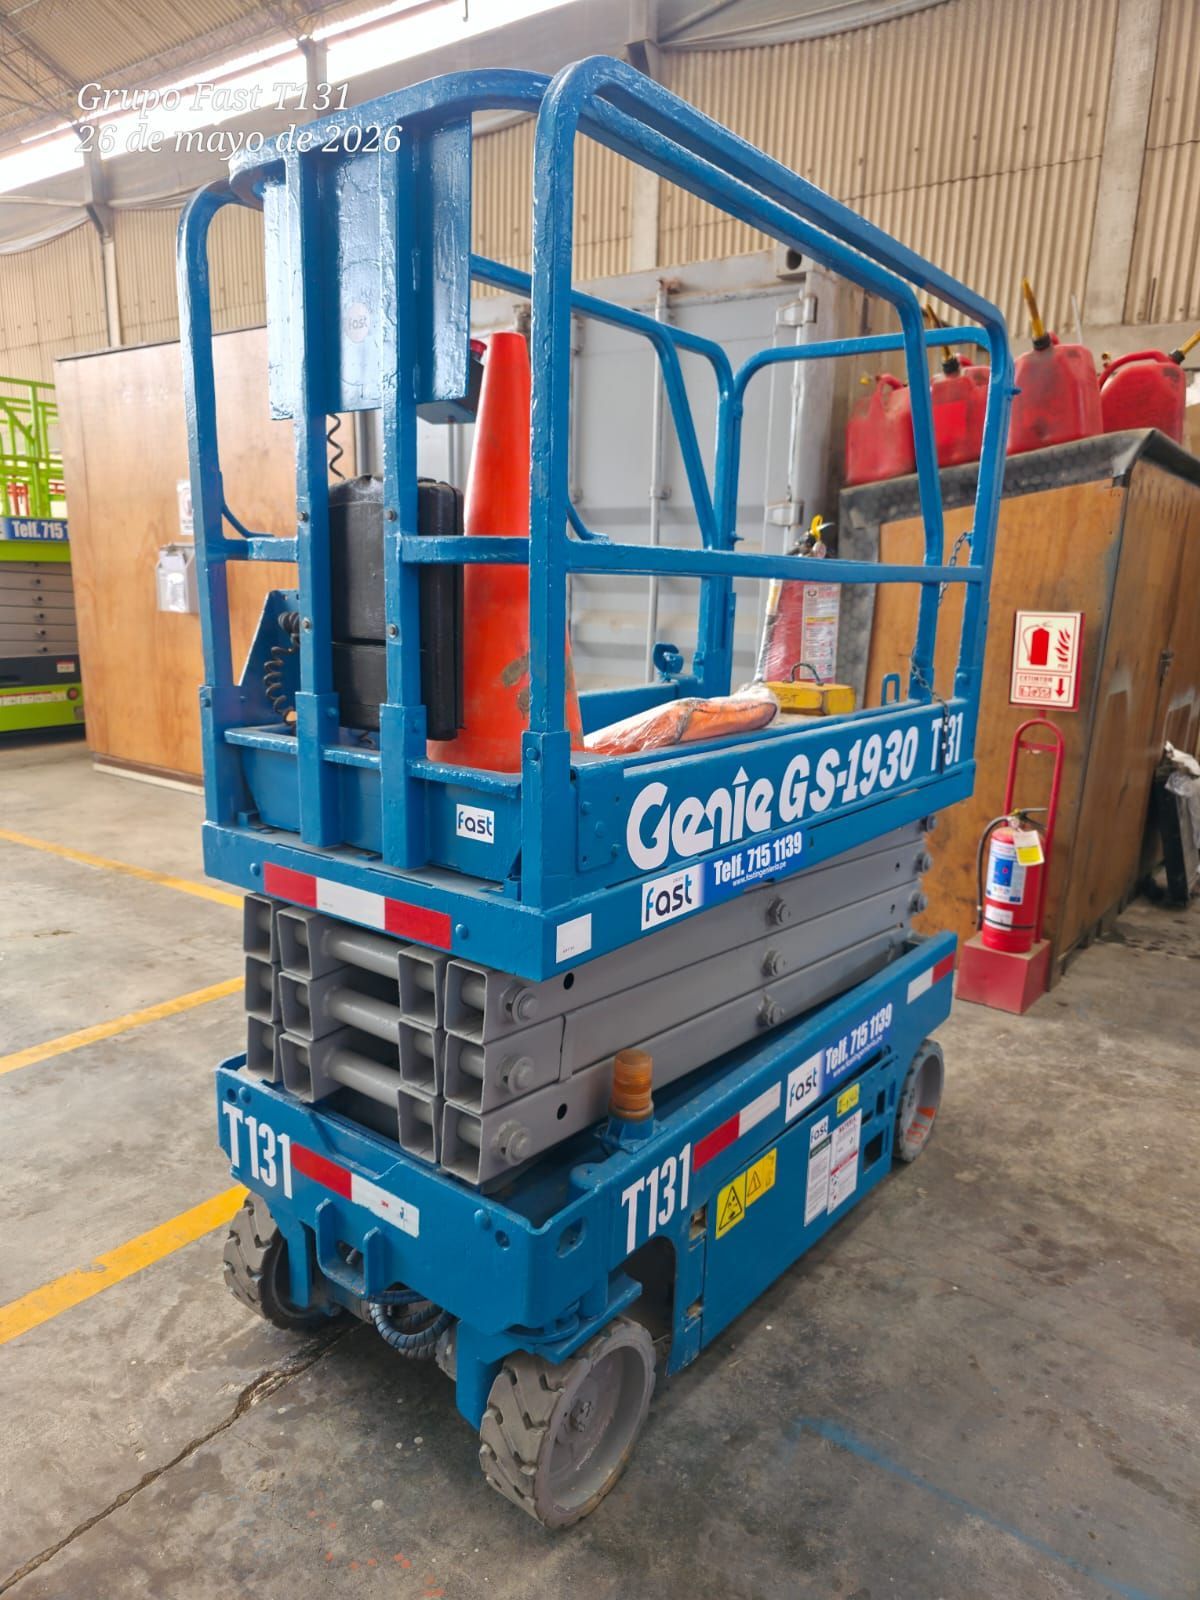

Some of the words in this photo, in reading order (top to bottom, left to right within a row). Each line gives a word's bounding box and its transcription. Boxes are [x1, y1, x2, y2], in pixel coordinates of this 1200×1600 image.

[41, 521, 63, 539] 715
[779, 725, 919, 823] GS-1930
[930, 712, 964, 772] T31
[457, 811, 493, 837] fast
[645, 873, 693, 922] fast
[713, 852, 745, 886] Telf.
[747, 842, 771, 873] 715
[773, 831, 803, 863] 1139
[788, 1067, 818, 1108] fast
[826, 1036, 848, 1075] Telf.
[850, 1020, 869, 1056] 715
[870, 1002, 893, 1041] 1139
[222, 1100, 293, 1201] T131
[621, 1142, 691, 1256] T131
